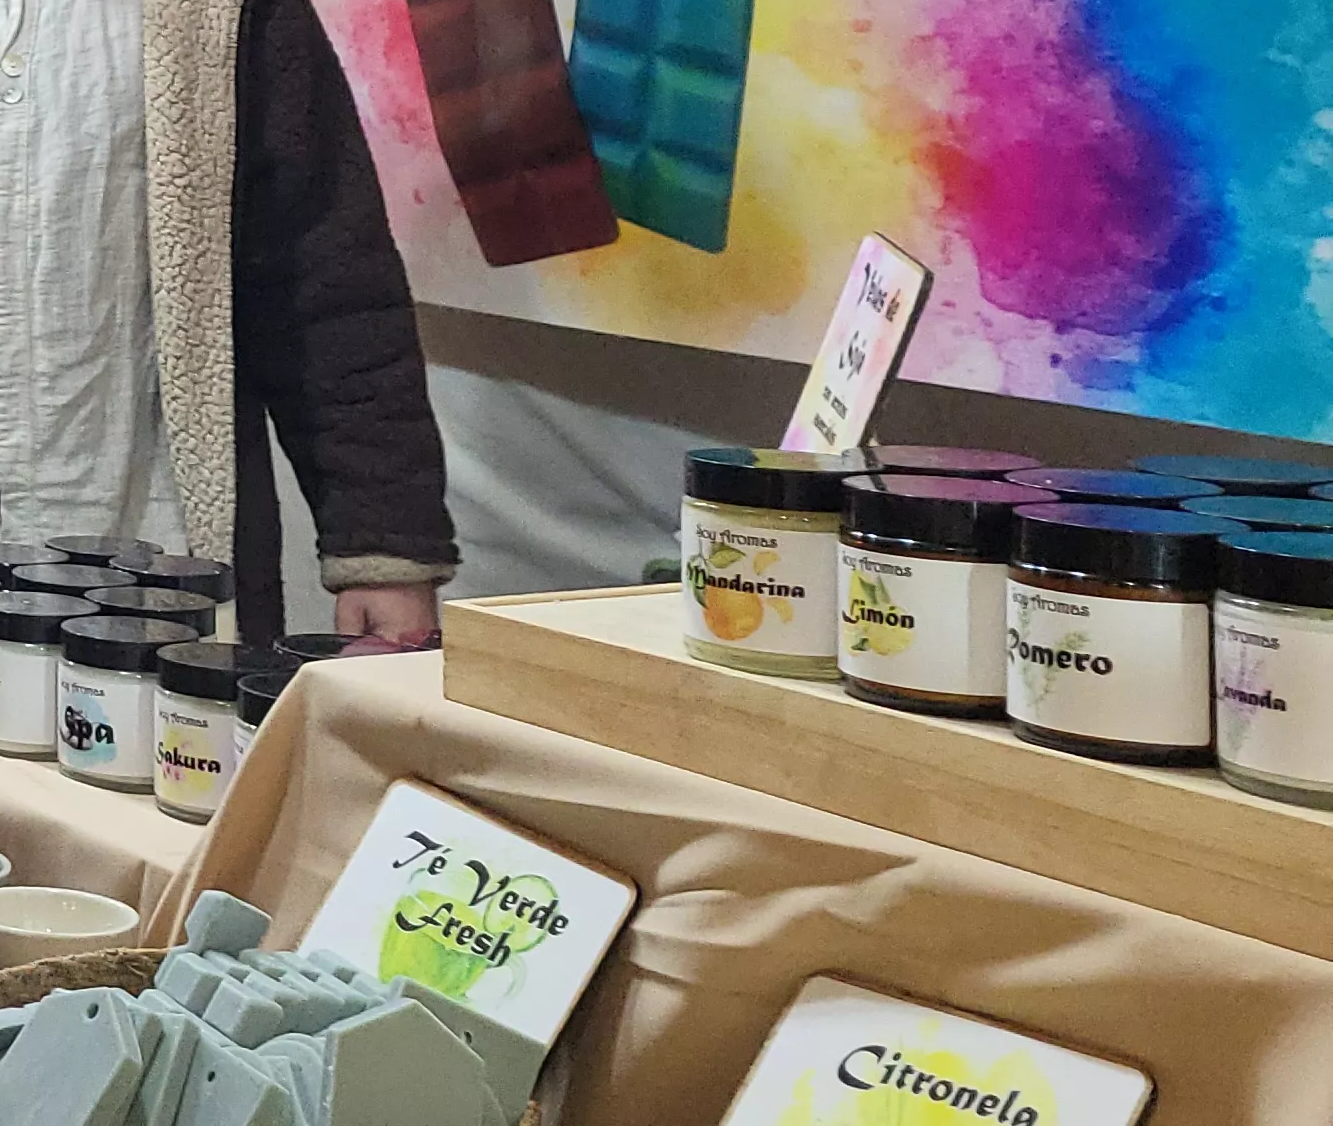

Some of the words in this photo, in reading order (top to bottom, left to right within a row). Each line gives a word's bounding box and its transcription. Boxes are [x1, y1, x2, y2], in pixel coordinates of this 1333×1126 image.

[696, 524, 716, 543] Soy
[719, 528, 779, 549] Aromas
[686, 561, 805, 599] Mandarina
[859, 557, 912, 577] Aromas
[842, 598, 915, 629] Limón
[1029, 594, 1091, 617] Aromas
[60, 705, 115, 750] Spa
[155, 741, 222, 774] Sakura
[392, 830, 453, 876] Té
[463, 859, 570, 936] Verde
[837, 1044, 1040, 1126] Citronela
